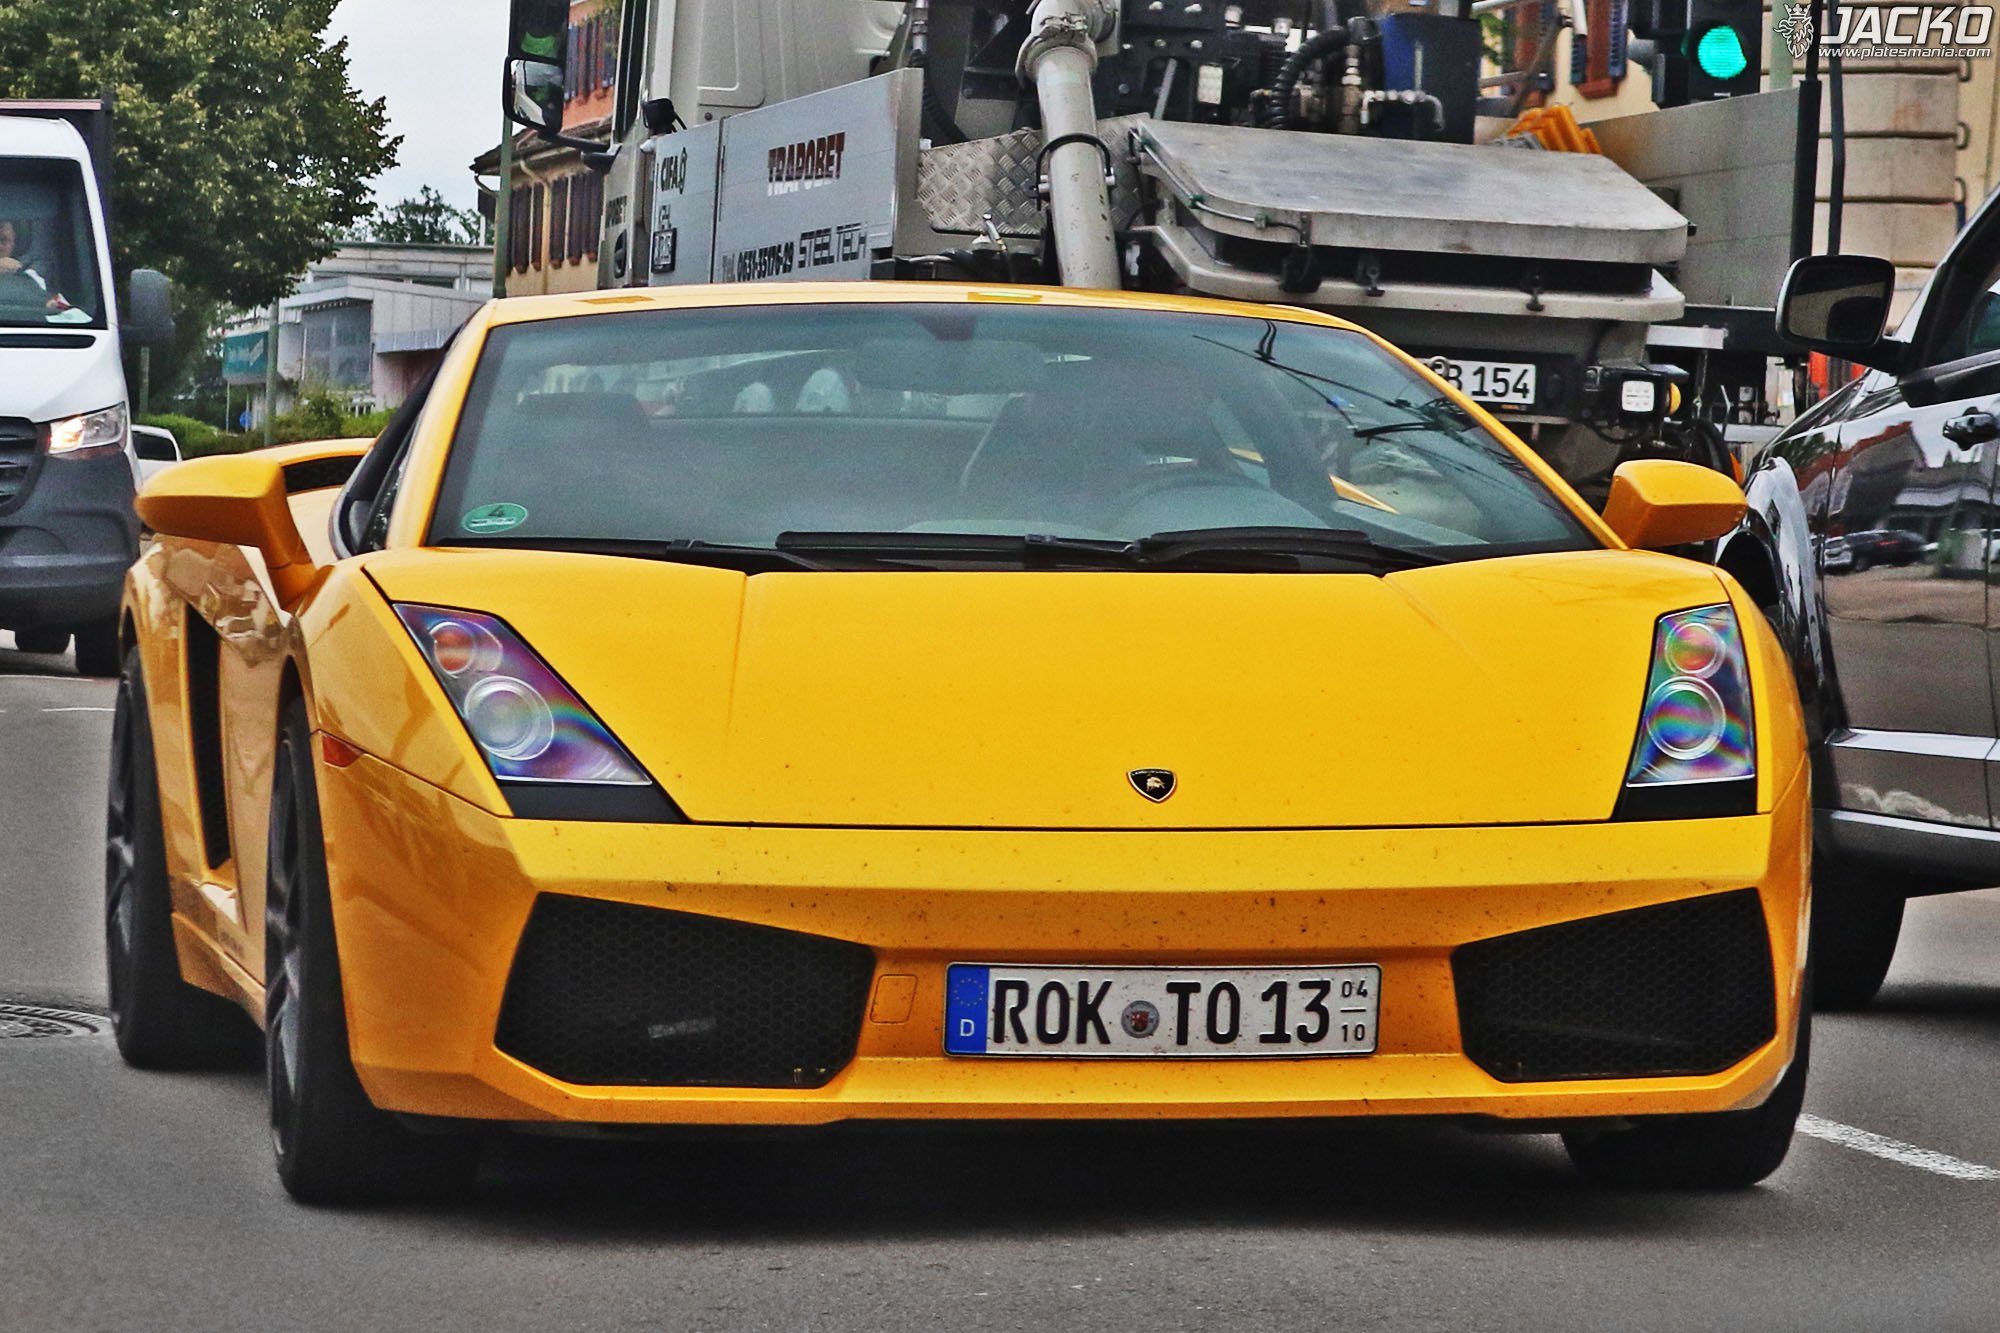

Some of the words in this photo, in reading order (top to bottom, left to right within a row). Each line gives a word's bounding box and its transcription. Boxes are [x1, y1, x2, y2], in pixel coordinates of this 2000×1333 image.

[1472, 366, 1530, 399] 154
[488, 504, 506, 517] 4
[1341, 980, 1369, 998] 04
[993, 980, 1113, 1045] ROK
[1166, 981, 1241, 1045] TO
[1259, 981, 1331, 1044] 13
[959, 1018, 975, 1037] D
[1341, 1024, 1367, 1043] 10
